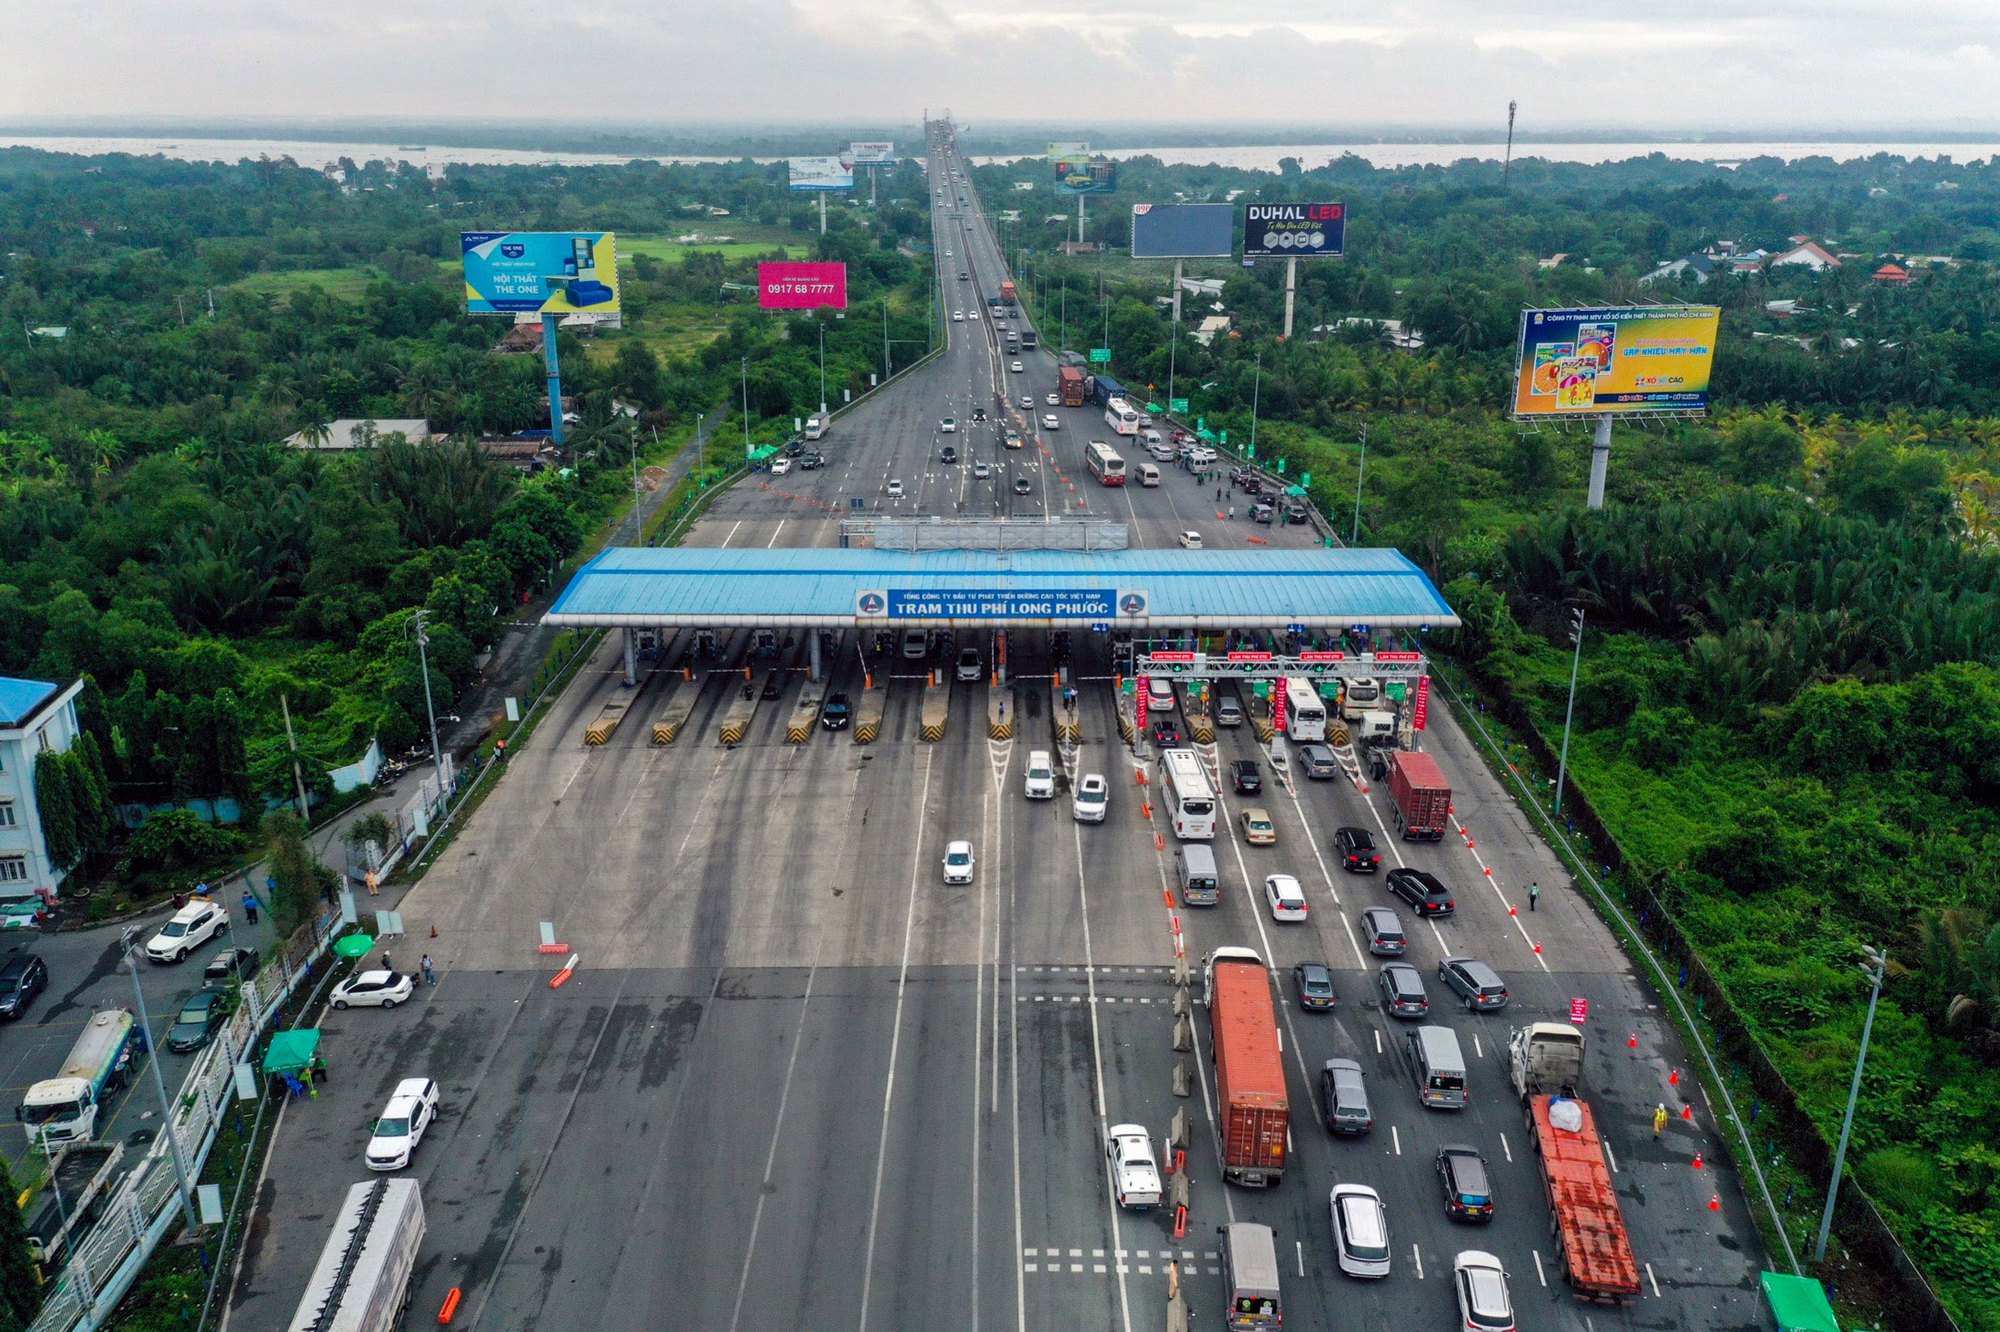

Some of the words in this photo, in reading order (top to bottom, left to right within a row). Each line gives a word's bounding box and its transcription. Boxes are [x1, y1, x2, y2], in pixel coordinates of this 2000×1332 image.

[1249, 206, 1305, 220] DUHAL
[1309, 205, 1342, 220] LED
[493, 273, 510, 285] NỘI
[512, 272, 538, 283] THẤT
[518, 286, 539, 294] ONE
[768, 284, 792, 294] 0917
[795, 284, 807, 294] 68
[810, 284, 834, 293] 7777
[896, 603, 942, 617] TRẠM
[946, 603, 977, 614] THU
[982, 600, 1008, 614] PHÍ
[1011, 603, 1052, 614] LONG
[1056, 600, 1108, 614] PHƯỚC
